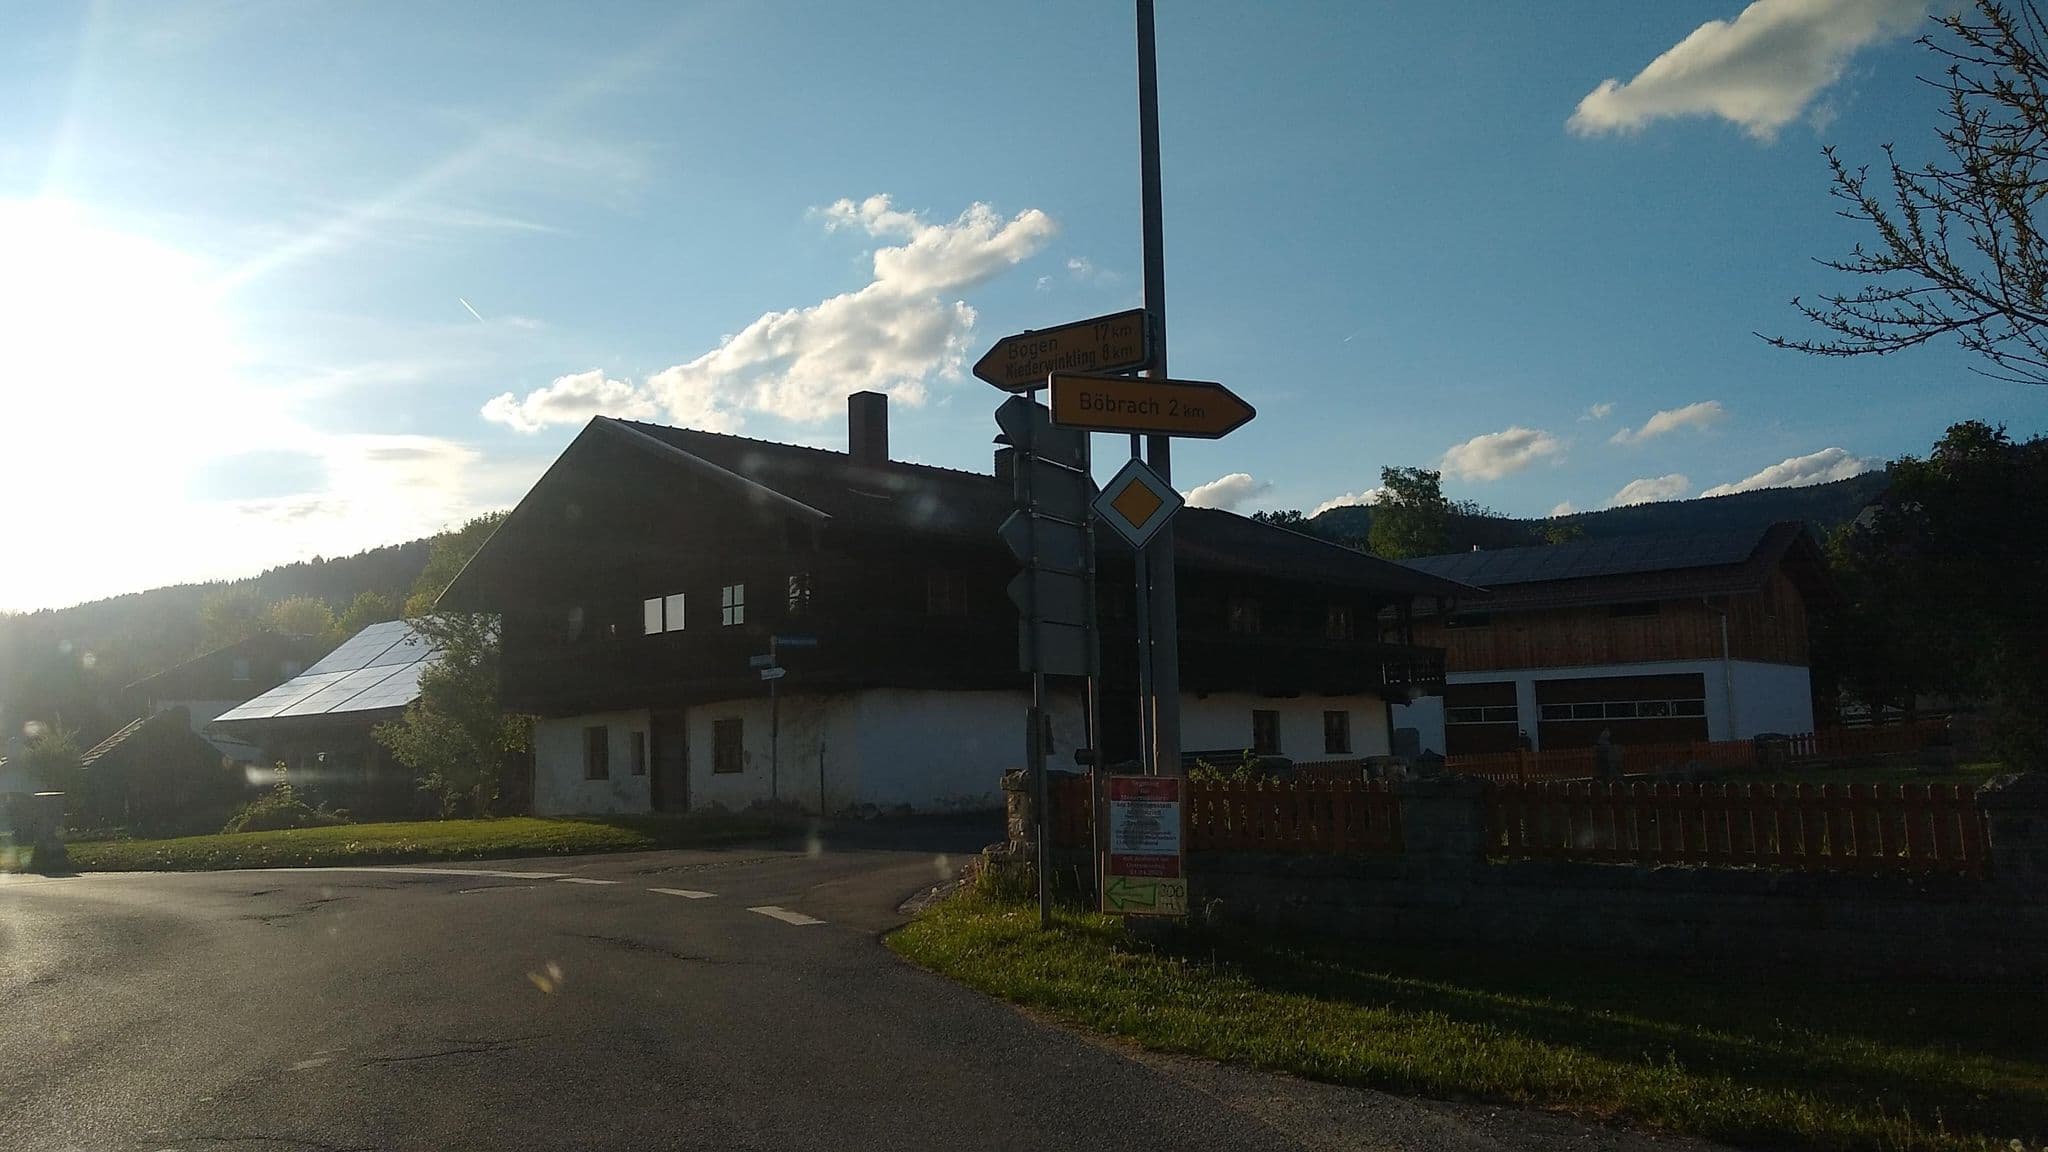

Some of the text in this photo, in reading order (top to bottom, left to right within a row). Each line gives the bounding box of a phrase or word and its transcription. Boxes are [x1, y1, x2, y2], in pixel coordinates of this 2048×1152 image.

[1008, 323, 1132, 360] Bogen 17 km
[1005, 343, 1133, 378] Niederwinkling 8 km
[1080, 392, 1205, 418] Böbrach 2 km
